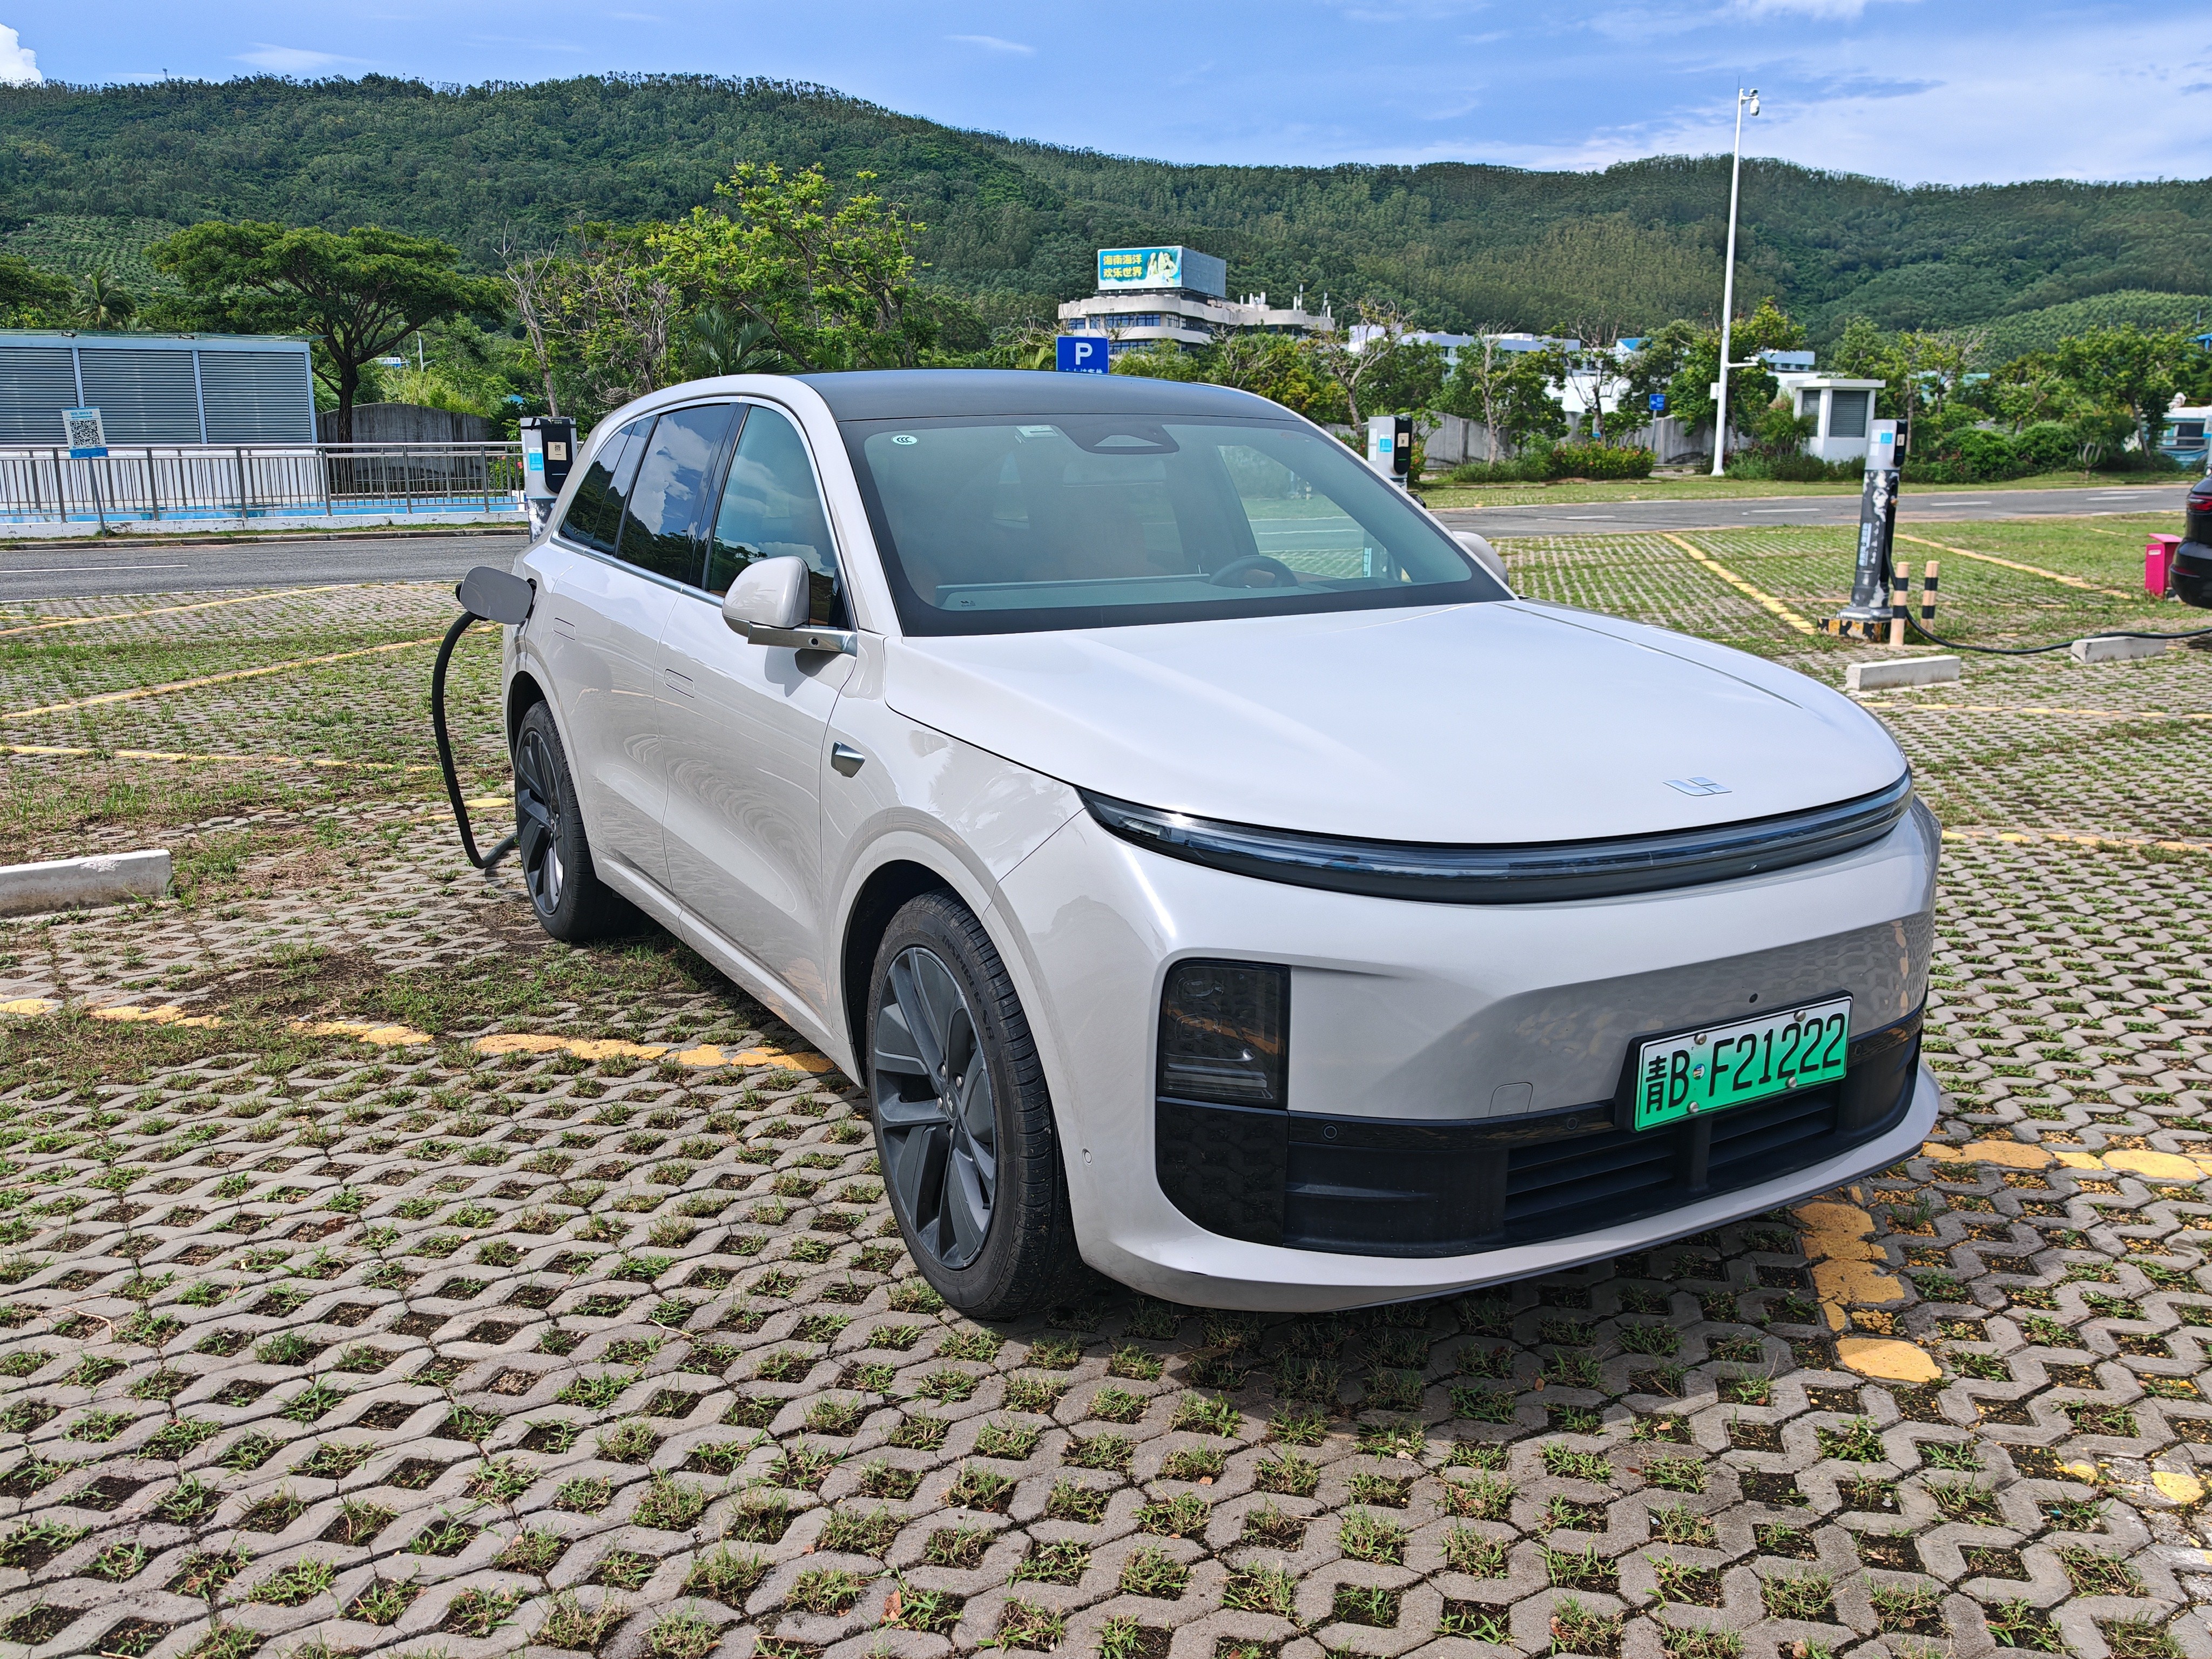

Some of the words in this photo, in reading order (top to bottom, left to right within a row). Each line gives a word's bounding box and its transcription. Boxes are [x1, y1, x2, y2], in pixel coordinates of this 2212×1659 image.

[1103, 253, 1142, 265] 海南海洋
[1103, 266, 1142, 278] 欢乐世界
[1075, 342, 1093, 365] P
[941, 934, 982, 1007] INSPIRER
[1645, 1049, 1690, 1114] 青B
[1708, 1013, 1845, 1097] F21222
